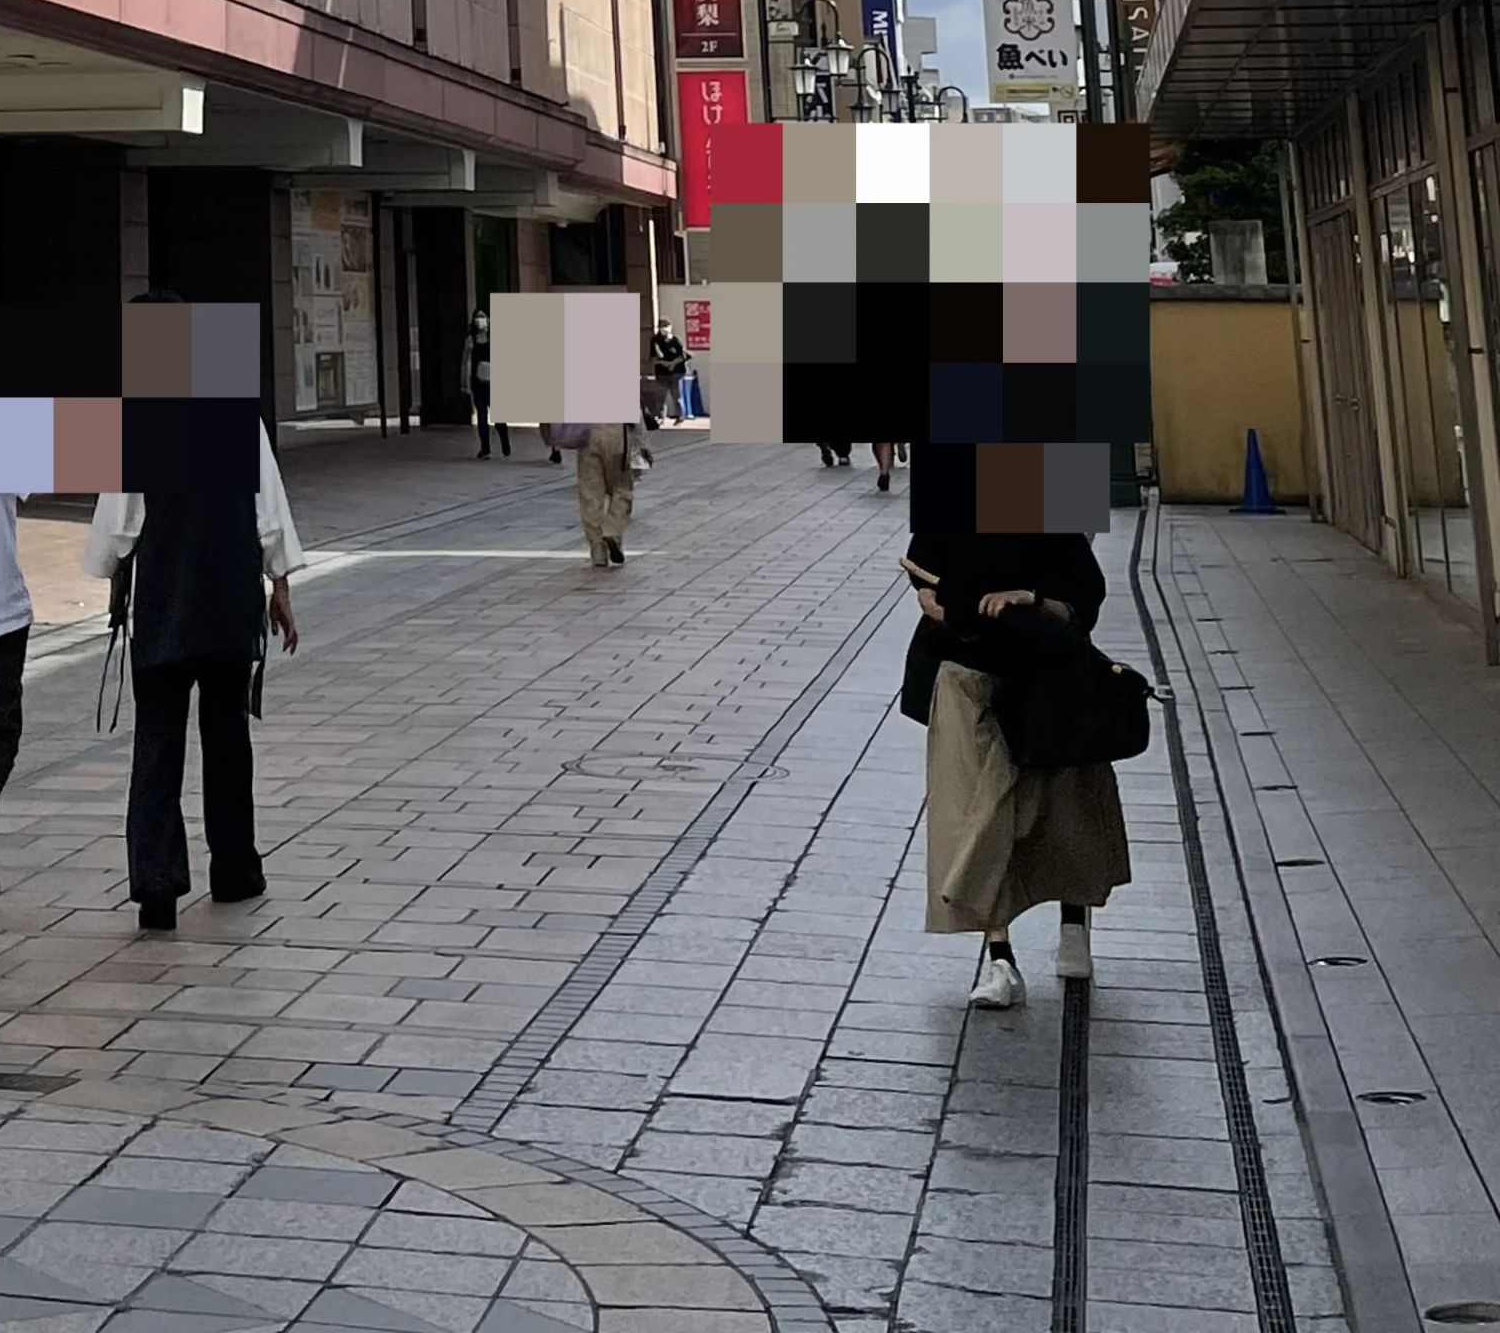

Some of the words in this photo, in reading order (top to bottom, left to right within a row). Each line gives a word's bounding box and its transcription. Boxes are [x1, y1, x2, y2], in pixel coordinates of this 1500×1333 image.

[700, 39, 719, 53] 2F
[996, 42, 1068, 70] 魚べい
